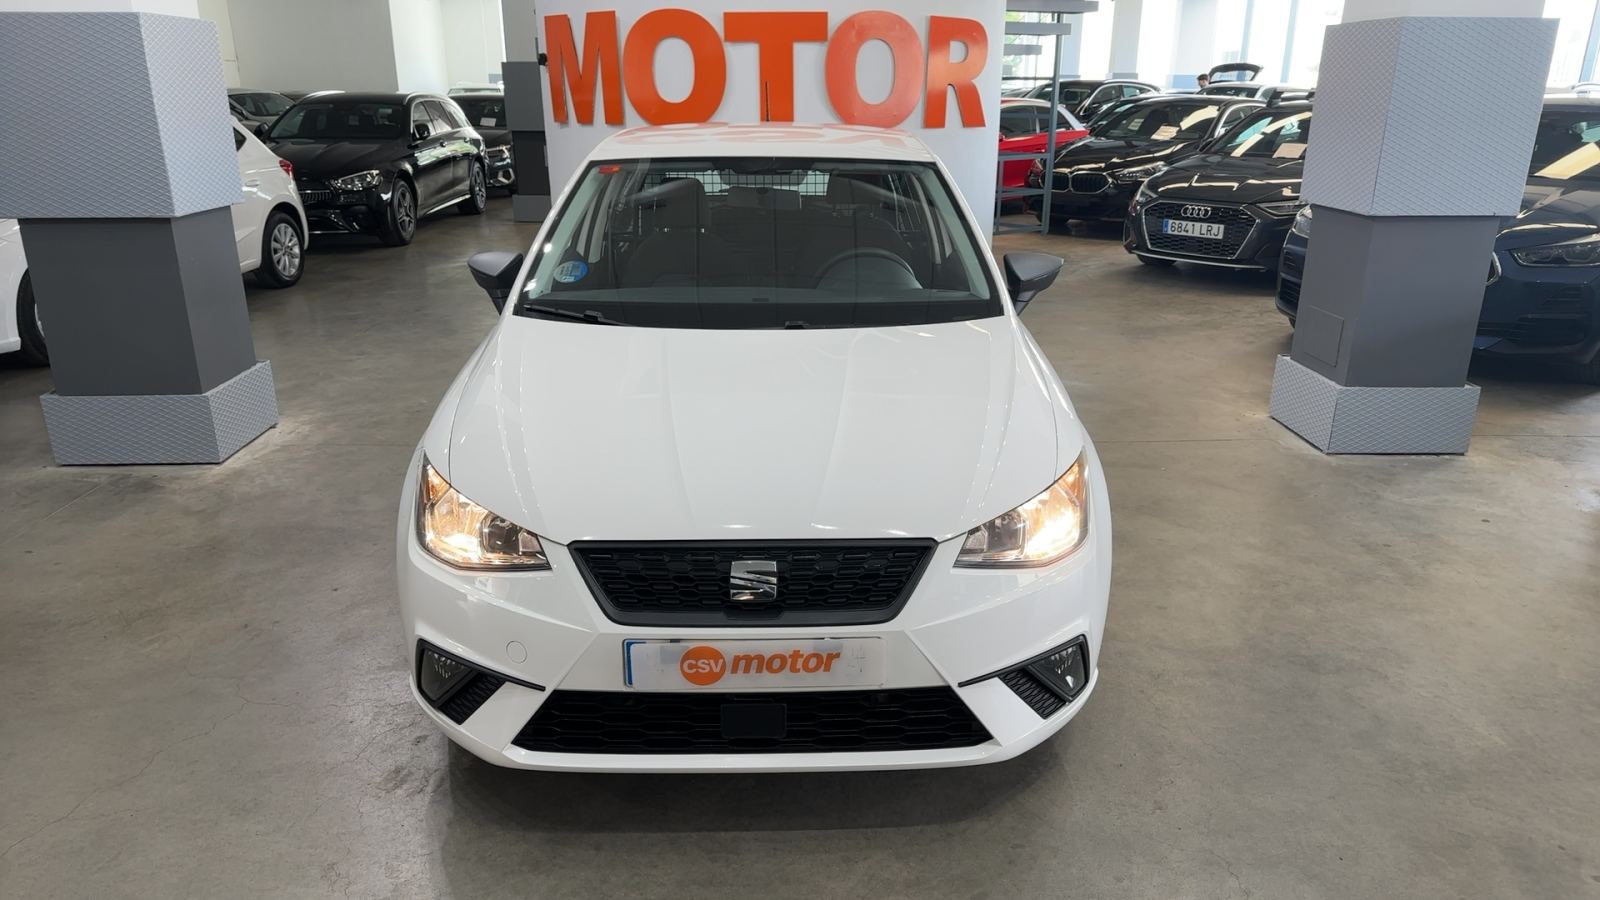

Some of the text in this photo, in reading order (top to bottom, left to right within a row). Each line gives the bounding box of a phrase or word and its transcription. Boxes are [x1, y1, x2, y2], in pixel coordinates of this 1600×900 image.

[544, 8, 989, 129] MOTOR
[1170, 221, 1221, 237] 6841 LRJ
[730, 649, 841, 675] motor
